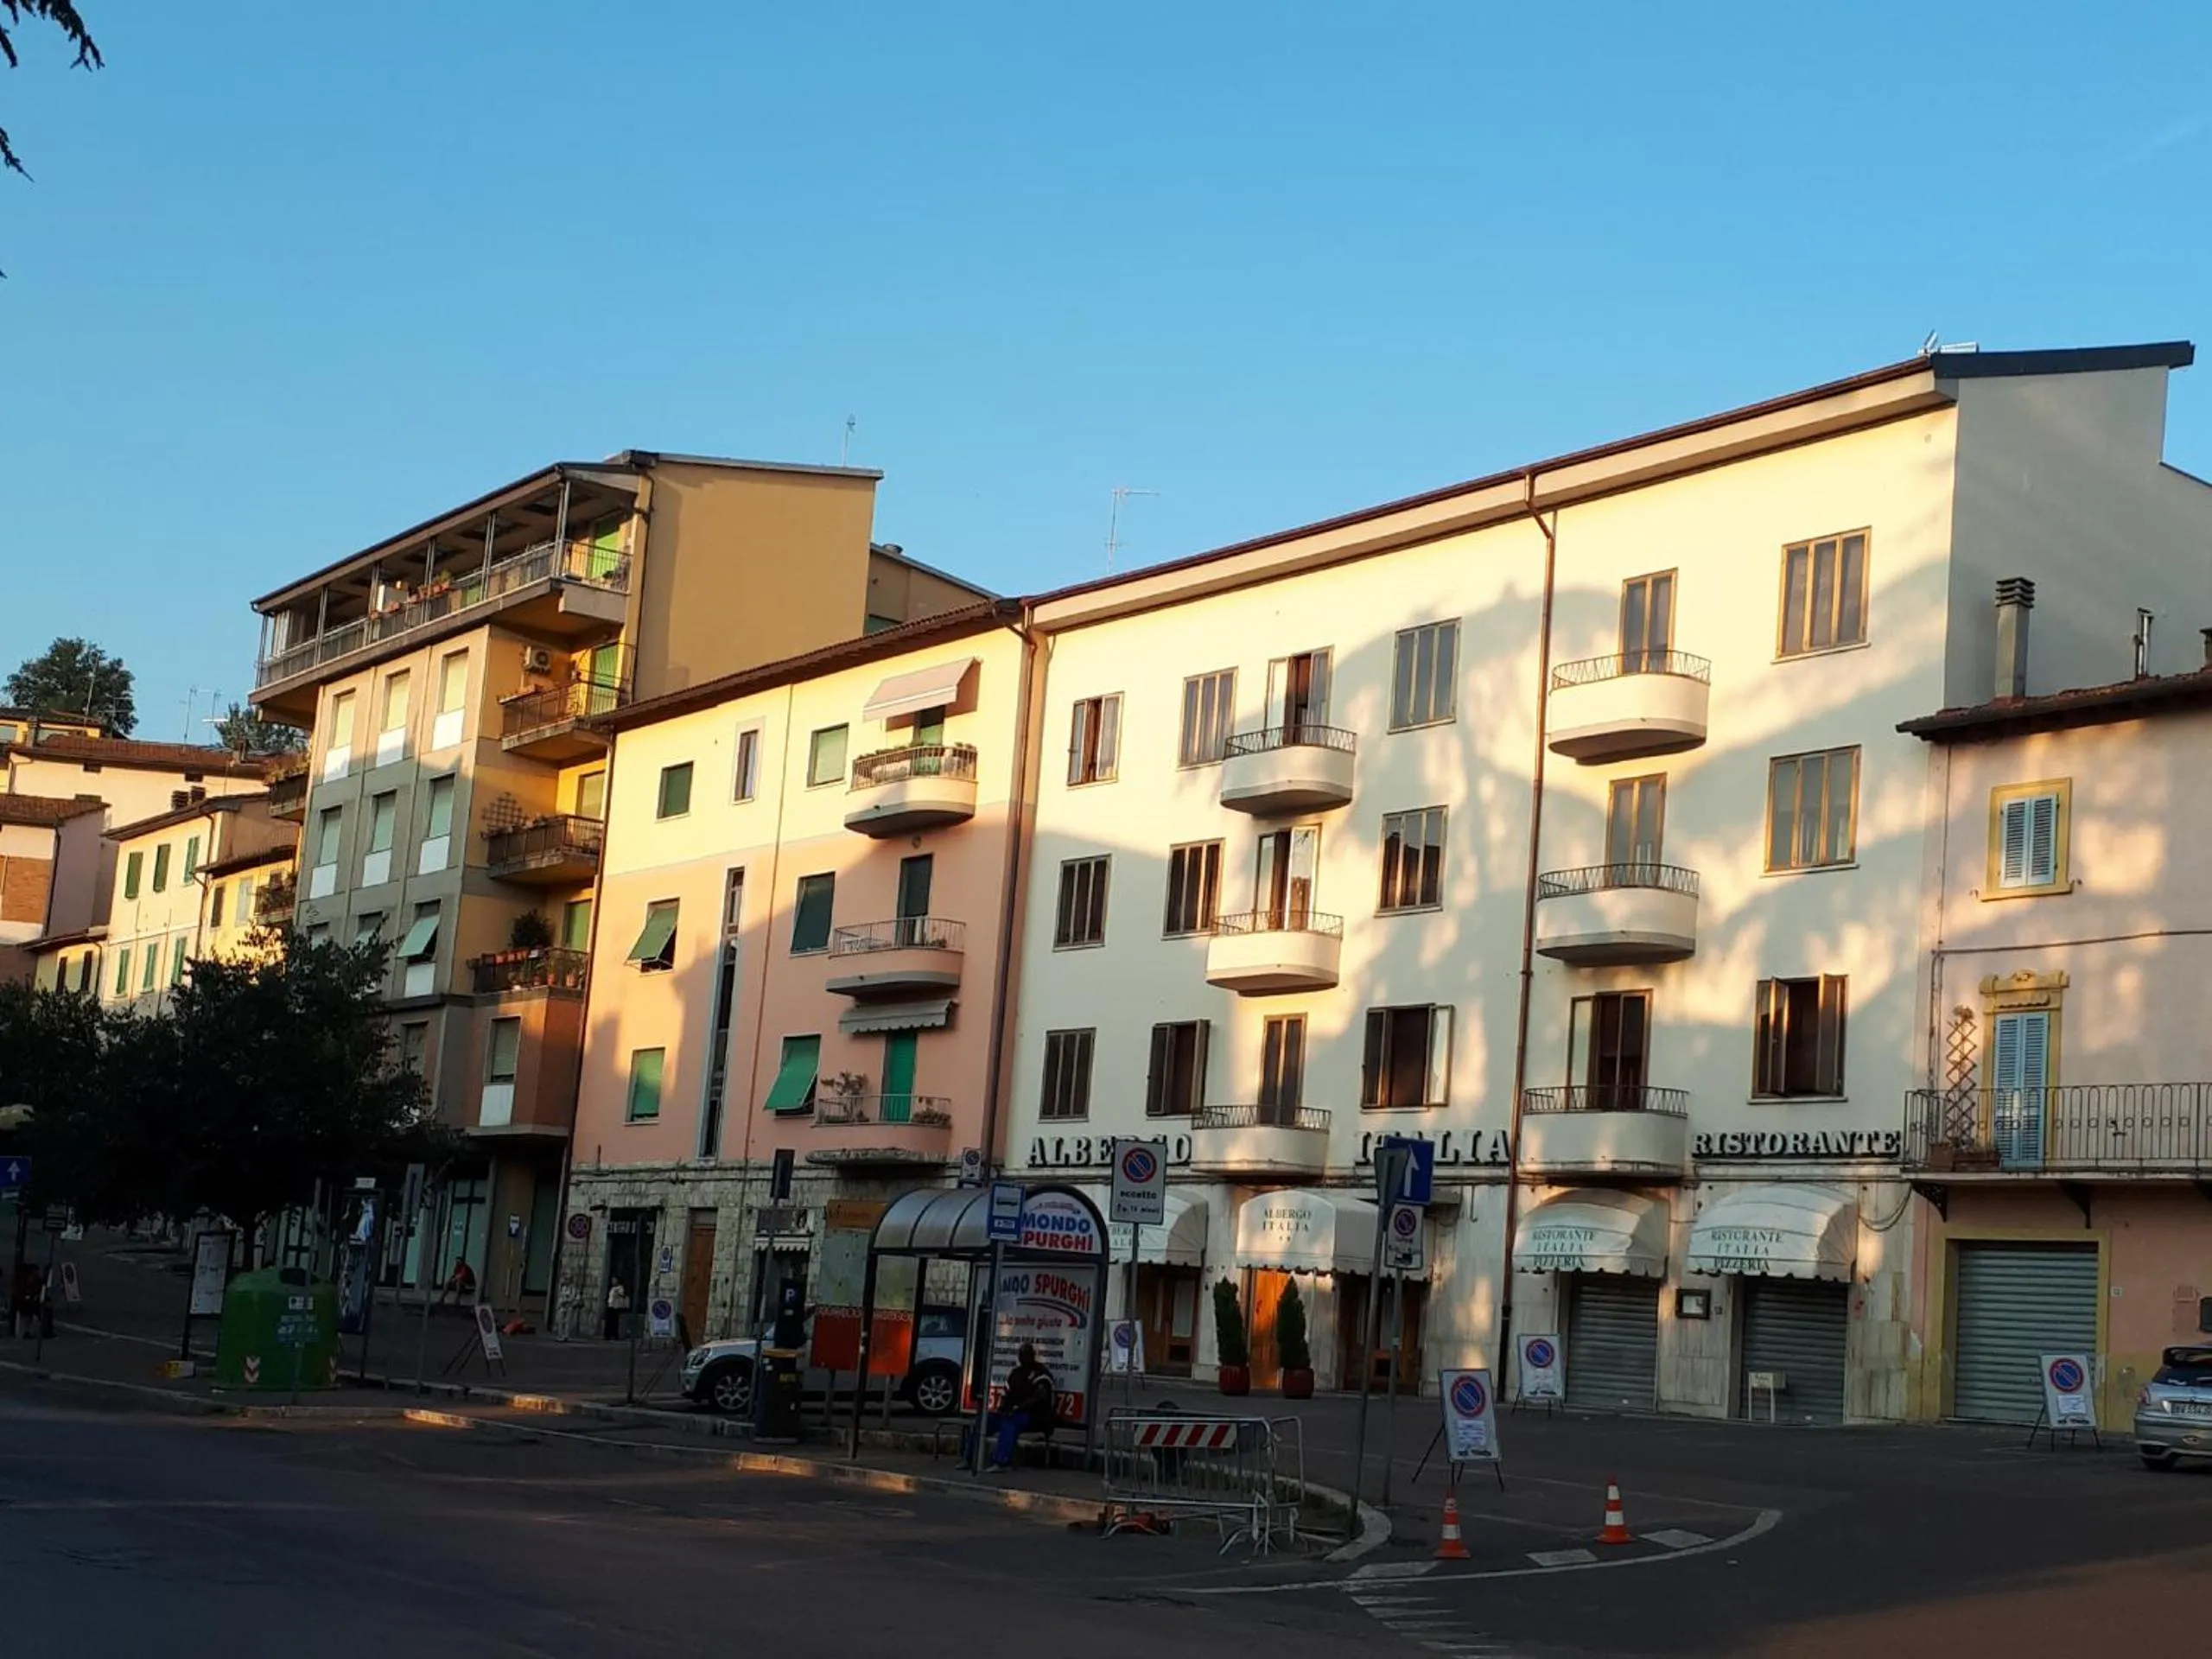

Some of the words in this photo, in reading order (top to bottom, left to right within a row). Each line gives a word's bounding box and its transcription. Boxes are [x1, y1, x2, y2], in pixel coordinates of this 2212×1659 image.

[1027, 1134, 1192, 1167] ALBEO
[1355, 1130, 1510, 1166] ILIA
[1691, 1130, 1901, 1159] RISTORANTE
[1263, 1209, 1313, 1219] ALBERGO
[1262, 1220, 1310, 1231] ITALIA
[1012, 1230, 1093, 1252] PURGHI
[1533, 1228, 1594, 1242] RISTORANTE
[1711, 1229, 1783, 1243] RISTORANTE
[1537, 1242, 1585, 1253] ITALIA
[1715, 1243, 1771, 1256] ITALIA
[1532, 1255, 1586, 1268] PIZZERIA
[1713, 1257, 1772, 1271] PIZZERIA
[784, 1287, 796, 1300] P
